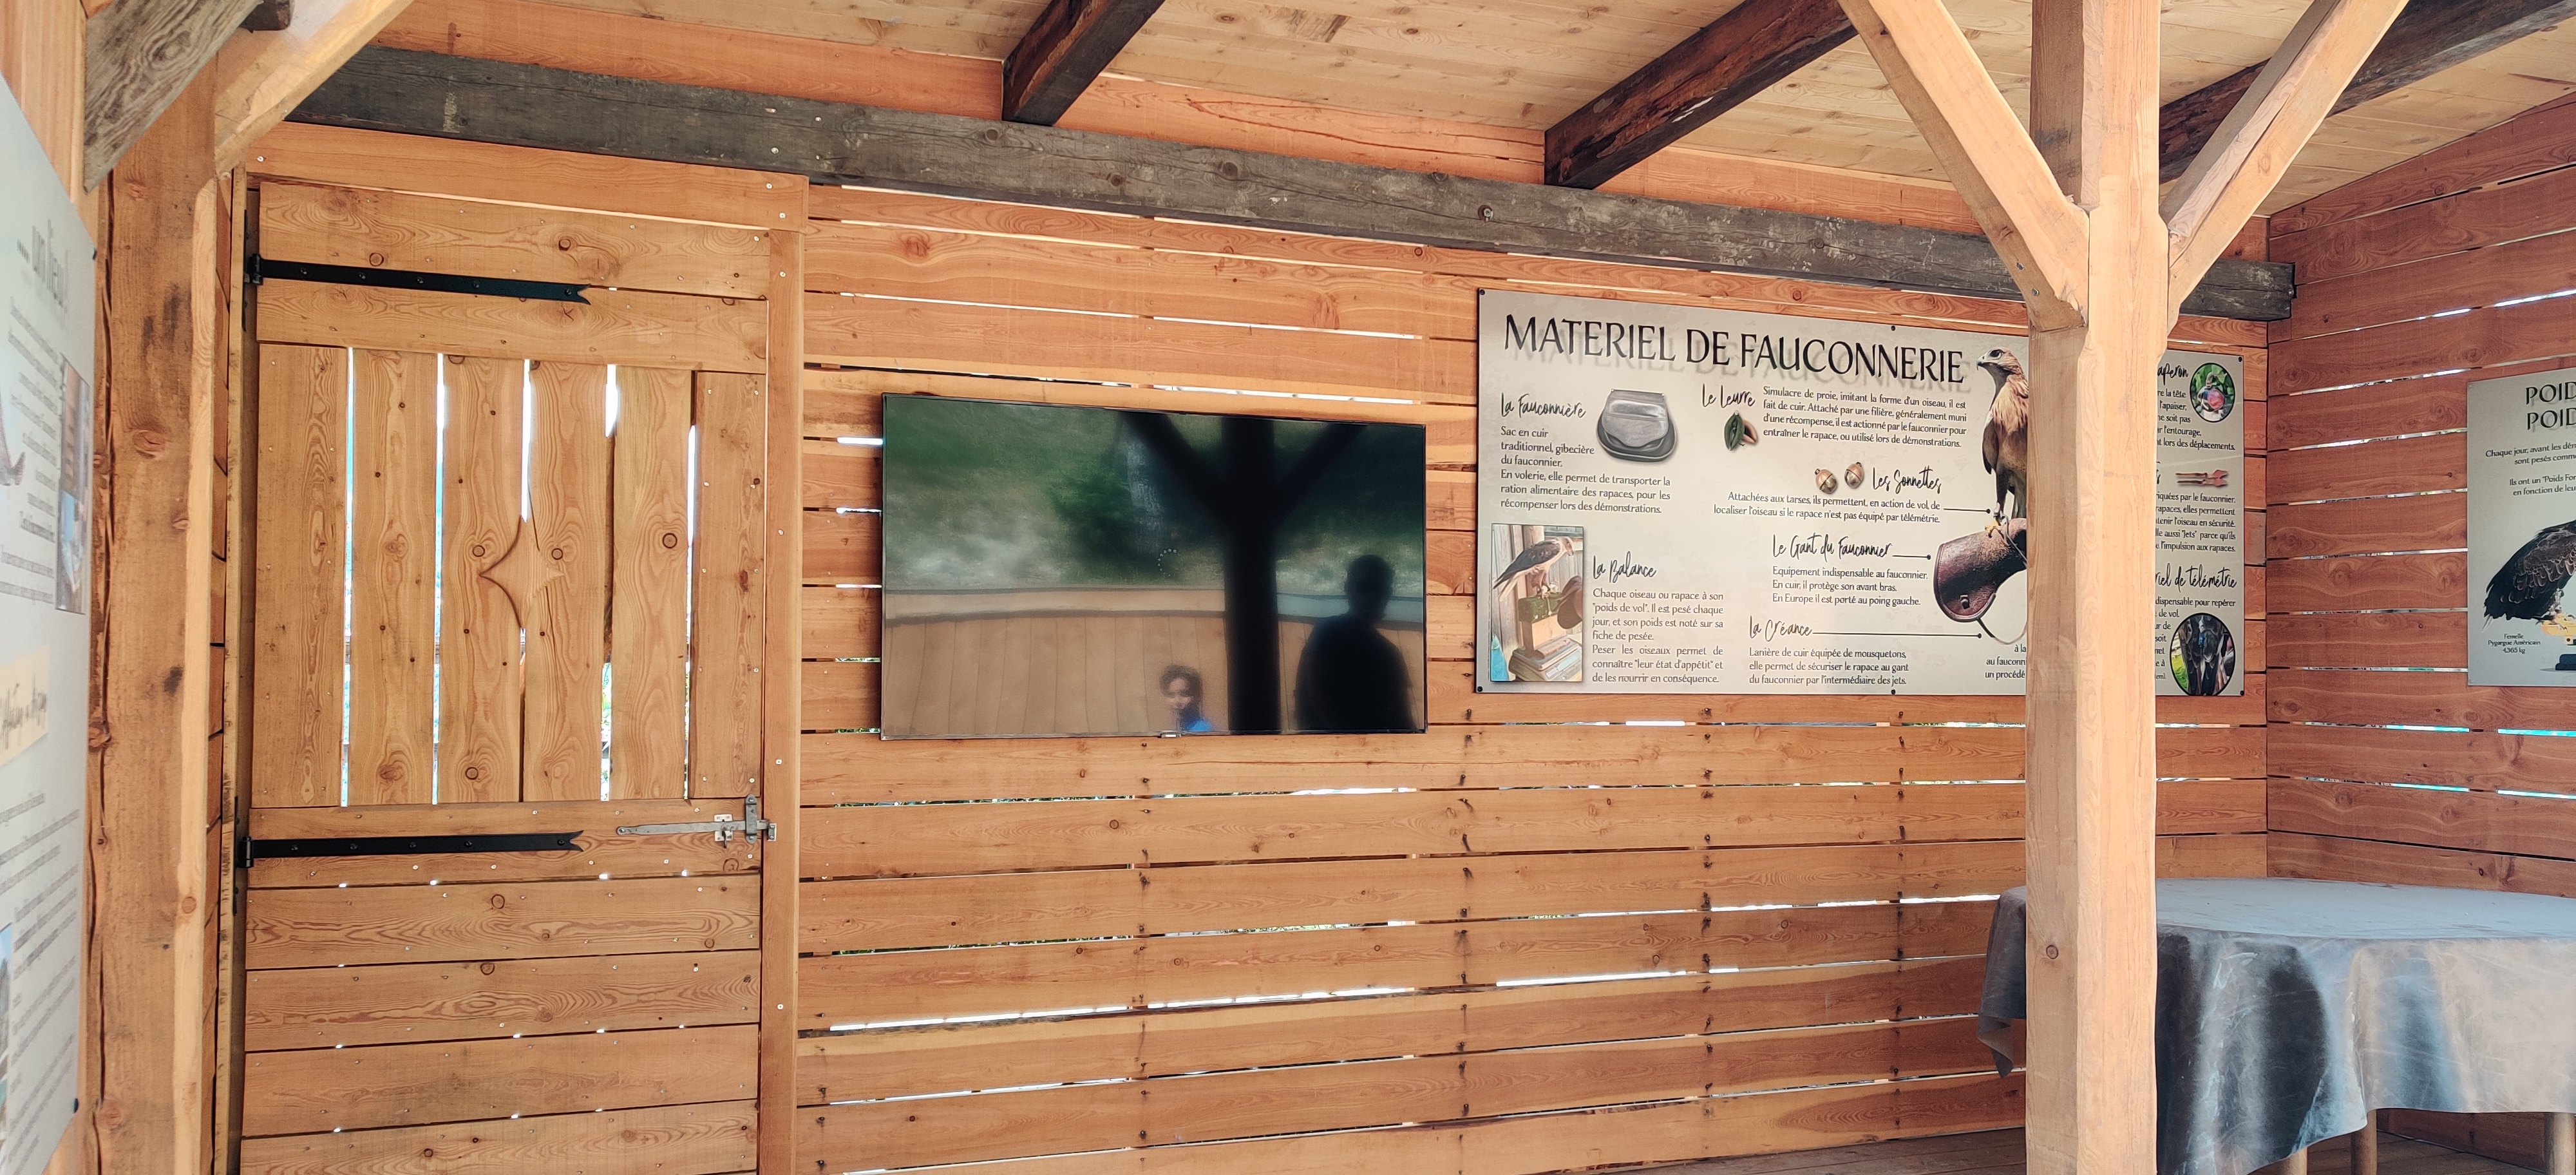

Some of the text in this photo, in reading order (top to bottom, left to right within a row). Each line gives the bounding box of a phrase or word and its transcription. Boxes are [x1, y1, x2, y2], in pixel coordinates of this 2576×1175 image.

[1504, 313, 1964, 383] MATERIEL DE FAUCONNERIE
[1720, 385, 1757, 408] Leurre
[1763, 387, 1803, 397] Simulacre
[1804, 390, 1815, 399] de
[1840, 392, 1869, 403] imitant
[1879, 394, 1903, 405] forme
[2172, 390, 2186, 398] tête
[2526, 381, 2576, 405] POID
[1518, 394, 1586, 418] Fauconnière
[1763, 400, 1777, 410] fait
[1777, 401, 1790, 410] de
[1806, 403, 1839, 414] Attaché
[1840, 407, 1854, 417] par
[1895, 409, 1947, 421] généralement
[1948, 412, 1967, 422] muni
[2166, 414, 2191, 425] soit pas
[2527, 407, 2576, 431] POID
[1501, 426, 1517, 437] Sac
[1531, 428, 1549, 438] cuir
[1785, 416, 1968, 437] récompense, est actionné par fauconnier pour
[1763, 428, 1801, 438] entraîner
[1810, 432, 1839, 442] rapace,
[1852, 432, 1875, 443] utilisé
[1875, 433, 1890, 443] lors
[1902, 435, 1962, 448] démonstrations.
[2164, 437, 2188, 447] lors des
[1501, 441, 1595, 456] traditionnel, gibecière
[2485, 444, 2550, 458] Chaque avant
[1501, 455, 1563, 468] du fauconnier.
[2514, 455, 2552, 465] sont pesés
[1501, 469, 1662, 488] En volerie, elle permet de transporter
[1872, 465, 1941, 494] Les Sonnettes
[1501, 484, 1671, 502] ration alimentaire des rapaces, pour les
[2180, 492, 2236, 504] par fauconnier.
[2523, 487, 2553, 495] fonction
[1501, 498, 1662, 513] récompenser lors des démonstrations.
[1727, 492, 1769, 502] Attachées
[1822, 497, 1868, 508] permettent,
[1880, 499, 1904, 509] action
[1930, 500, 1941, 510] de
[1714, 504, 1941, 524] localiser l'oiseau rapace pas équipé par télémétrie.
[2183, 504, 2236, 516] elles permettent
[2164, 529, 2218, 540] aussi parce
[1790, 533, 1823, 560] Gant
[1820, 534, 1834, 562] du
[1838, 536, 1892, 559] Fauconnier
[2161, 540, 2195, 552] l'impulsion
[1609, 551, 1657, 583] Balance
[1772, 566, 1929, 580] Equipement indispensable fauconnier.
[2174, 566, 2186, 593] de
[2186, 564, 2237, 588] télémétrie
[1772, 579, 1783, 589] En
[1809, 581, 1840, 593] protège
[1856, 583, 1878, 591] avant
[1593, 589, 1627, 601] Chaque
[1629, 589, 1656, 599] oiseau
[1671, 593, 1700, 602] rapace
[1772, 593, 1783, 602] En
[1785, 593, 1814, 606] Europe
[1821, 595, 1833, 604] est
[1834, 595, 1857, 606] porté
[1869, 595, 1891, 607] poing
[1891, 595, 1921, 607] gauche.
[1619, 603, 1723, 617] de est pesé chaque
[2211, 598, 2236, 609] repérer
[1640, 617, 1663, 629] poids
[1665, 619, 1678, 627] est
[1679, 618, 1698, 627] noté
[1592, 630, 1627, 640] fiche de
[1765, 619, 1813, 642] Créance
[1592, 644, 1707, 658] Peser les oiseaux permet
[1749, 647, 1907, 661] Lanière équipée mousquetons,
[1592, 659, 1673, 669] connaître état
[1996, 656, 2026, 665] fauconn
[1765, 662, 1909, 674] permet sécuriser rapace gant
[1618, 673, 1719, 685] nourrir conséquence.
[1761, 674, 1877, 685] fauconnier l'intermédiaire
